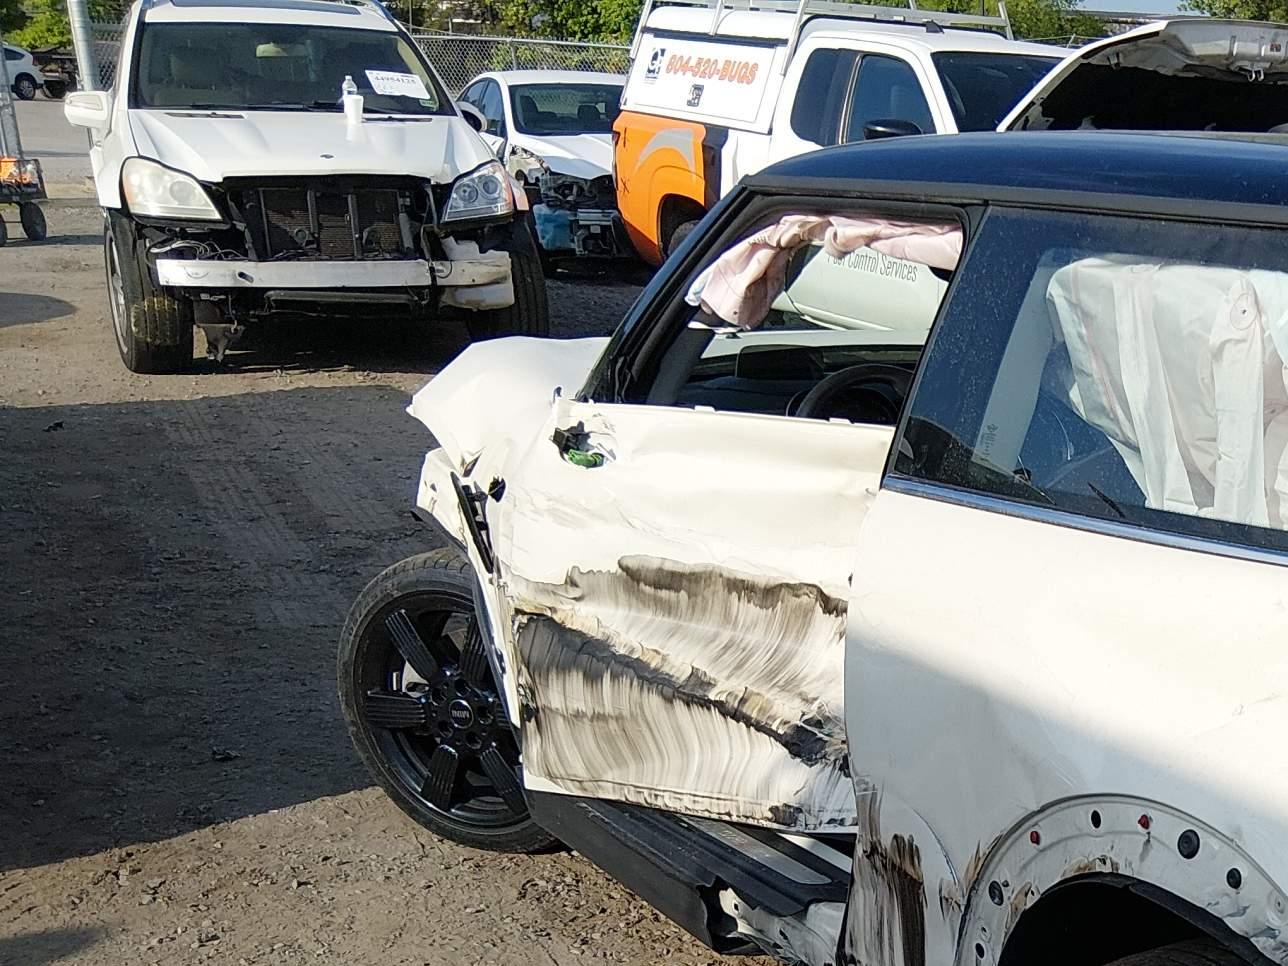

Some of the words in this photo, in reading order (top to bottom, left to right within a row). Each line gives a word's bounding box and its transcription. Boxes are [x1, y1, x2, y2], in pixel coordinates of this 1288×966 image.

[665, 54, 759, 85] 804-520-BUGS
[848, 251, 880, 273] Control
[880, 254, 918, 282] Services
